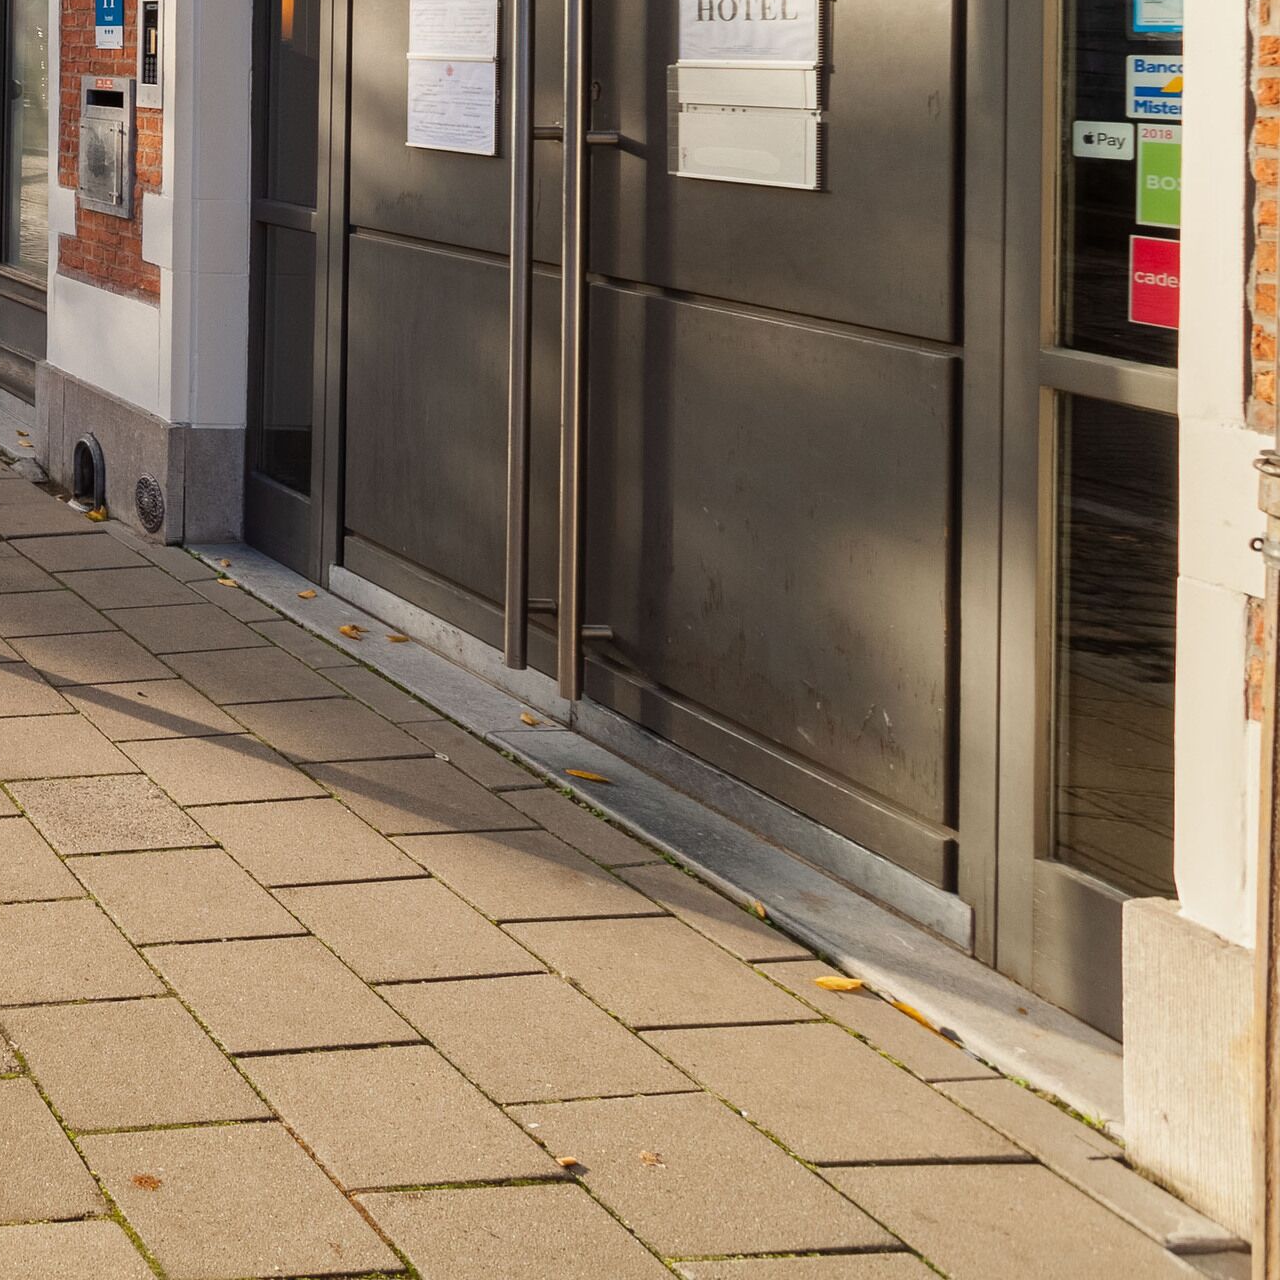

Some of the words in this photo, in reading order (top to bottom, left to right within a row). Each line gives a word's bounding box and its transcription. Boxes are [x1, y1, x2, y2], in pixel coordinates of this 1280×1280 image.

[1097, 132, 1126, 150] Pay
[1141, 128, 1173, 140] 2018
[1146, 174, 1183, 191] BO
[1134, 271, 1180, 288] cade
